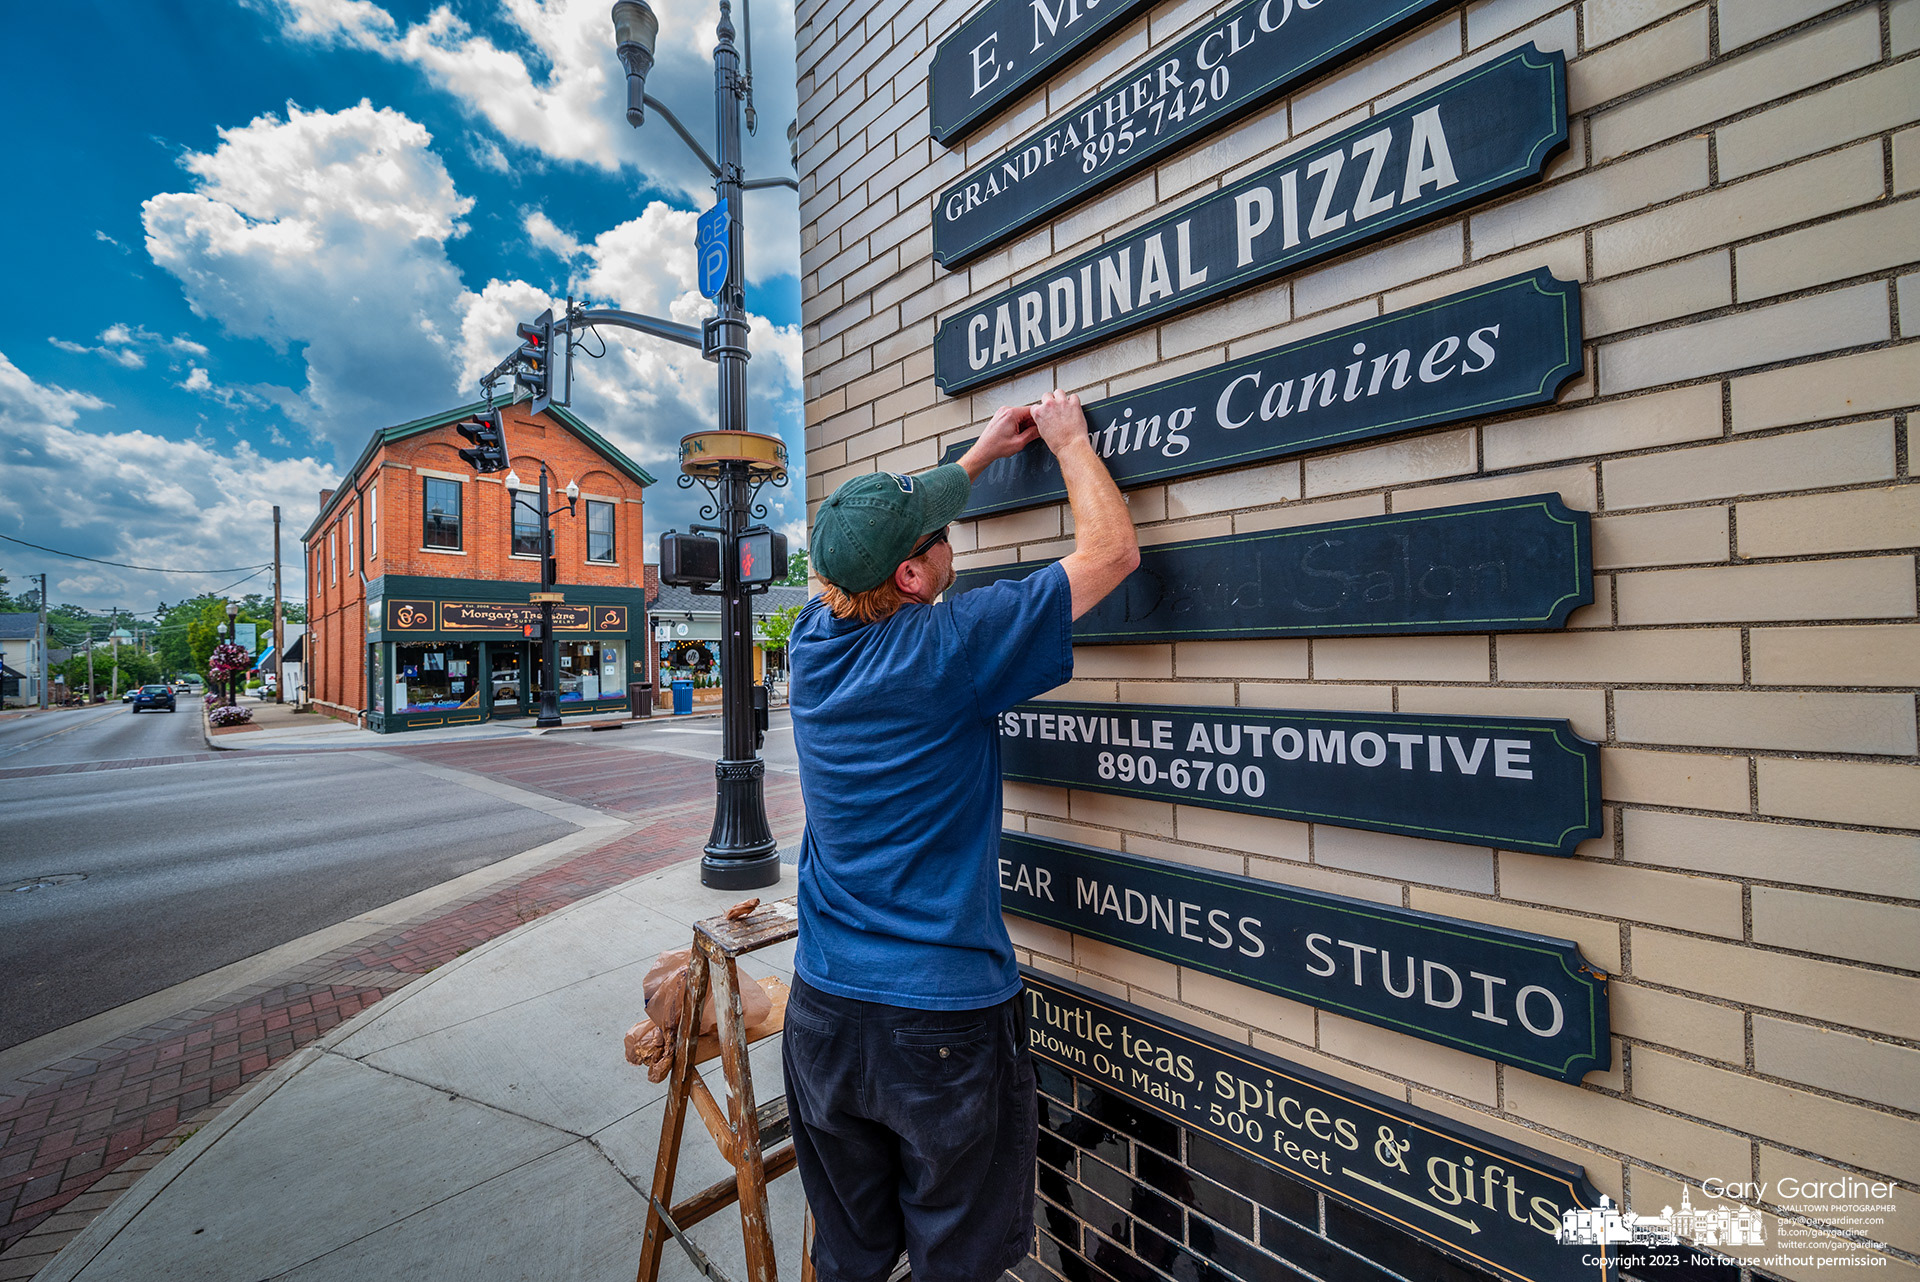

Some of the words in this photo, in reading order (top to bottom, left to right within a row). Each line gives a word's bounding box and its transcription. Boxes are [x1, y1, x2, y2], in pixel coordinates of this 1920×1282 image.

[969, 31, 1014, 99] E.
[1029, 0, 1101, 54] M
[945, 58, 1184, 222] GRANDFATHER
[1196, 0, 1324, 70] CLO
[1082, 65, 1230, 174] 895-7420
[707, 249, 723, 292] P
[967, 219, 1208, 371] CARDINAL
[1234, 104, 1460, 268] PIZZA
[1215, 323, 1500, 429] Canines
[461, 609, 519, 621] Morgan's
[521, 610, 575, 620] Tresure
[1296, 533, 1510, 613] Salon
[1097, 751, 1266, 798] 890-6700
[1186, 723, 1533, 780] AUTOMOTIVE
[1076, 876, 1266, 959] MADNESS
[1305, 932, 1565, 1038] STUDIO
[1025, 988, 1114, 1050] Turtle
[1121, 1026, 1205, 1092] teas,
[1215, 1070, 1359, 1151] spices
[1374, 1125, 1411, 1175] &
[1426, 1154, 1563, 1236] gifts
[1093, 1053, 1124, 1083] On
[1131, 1067, 1187, 1111] Main
[1209, 1102, 1264, 1144] 500
[1273, 1129, 1333, 1175] feet
